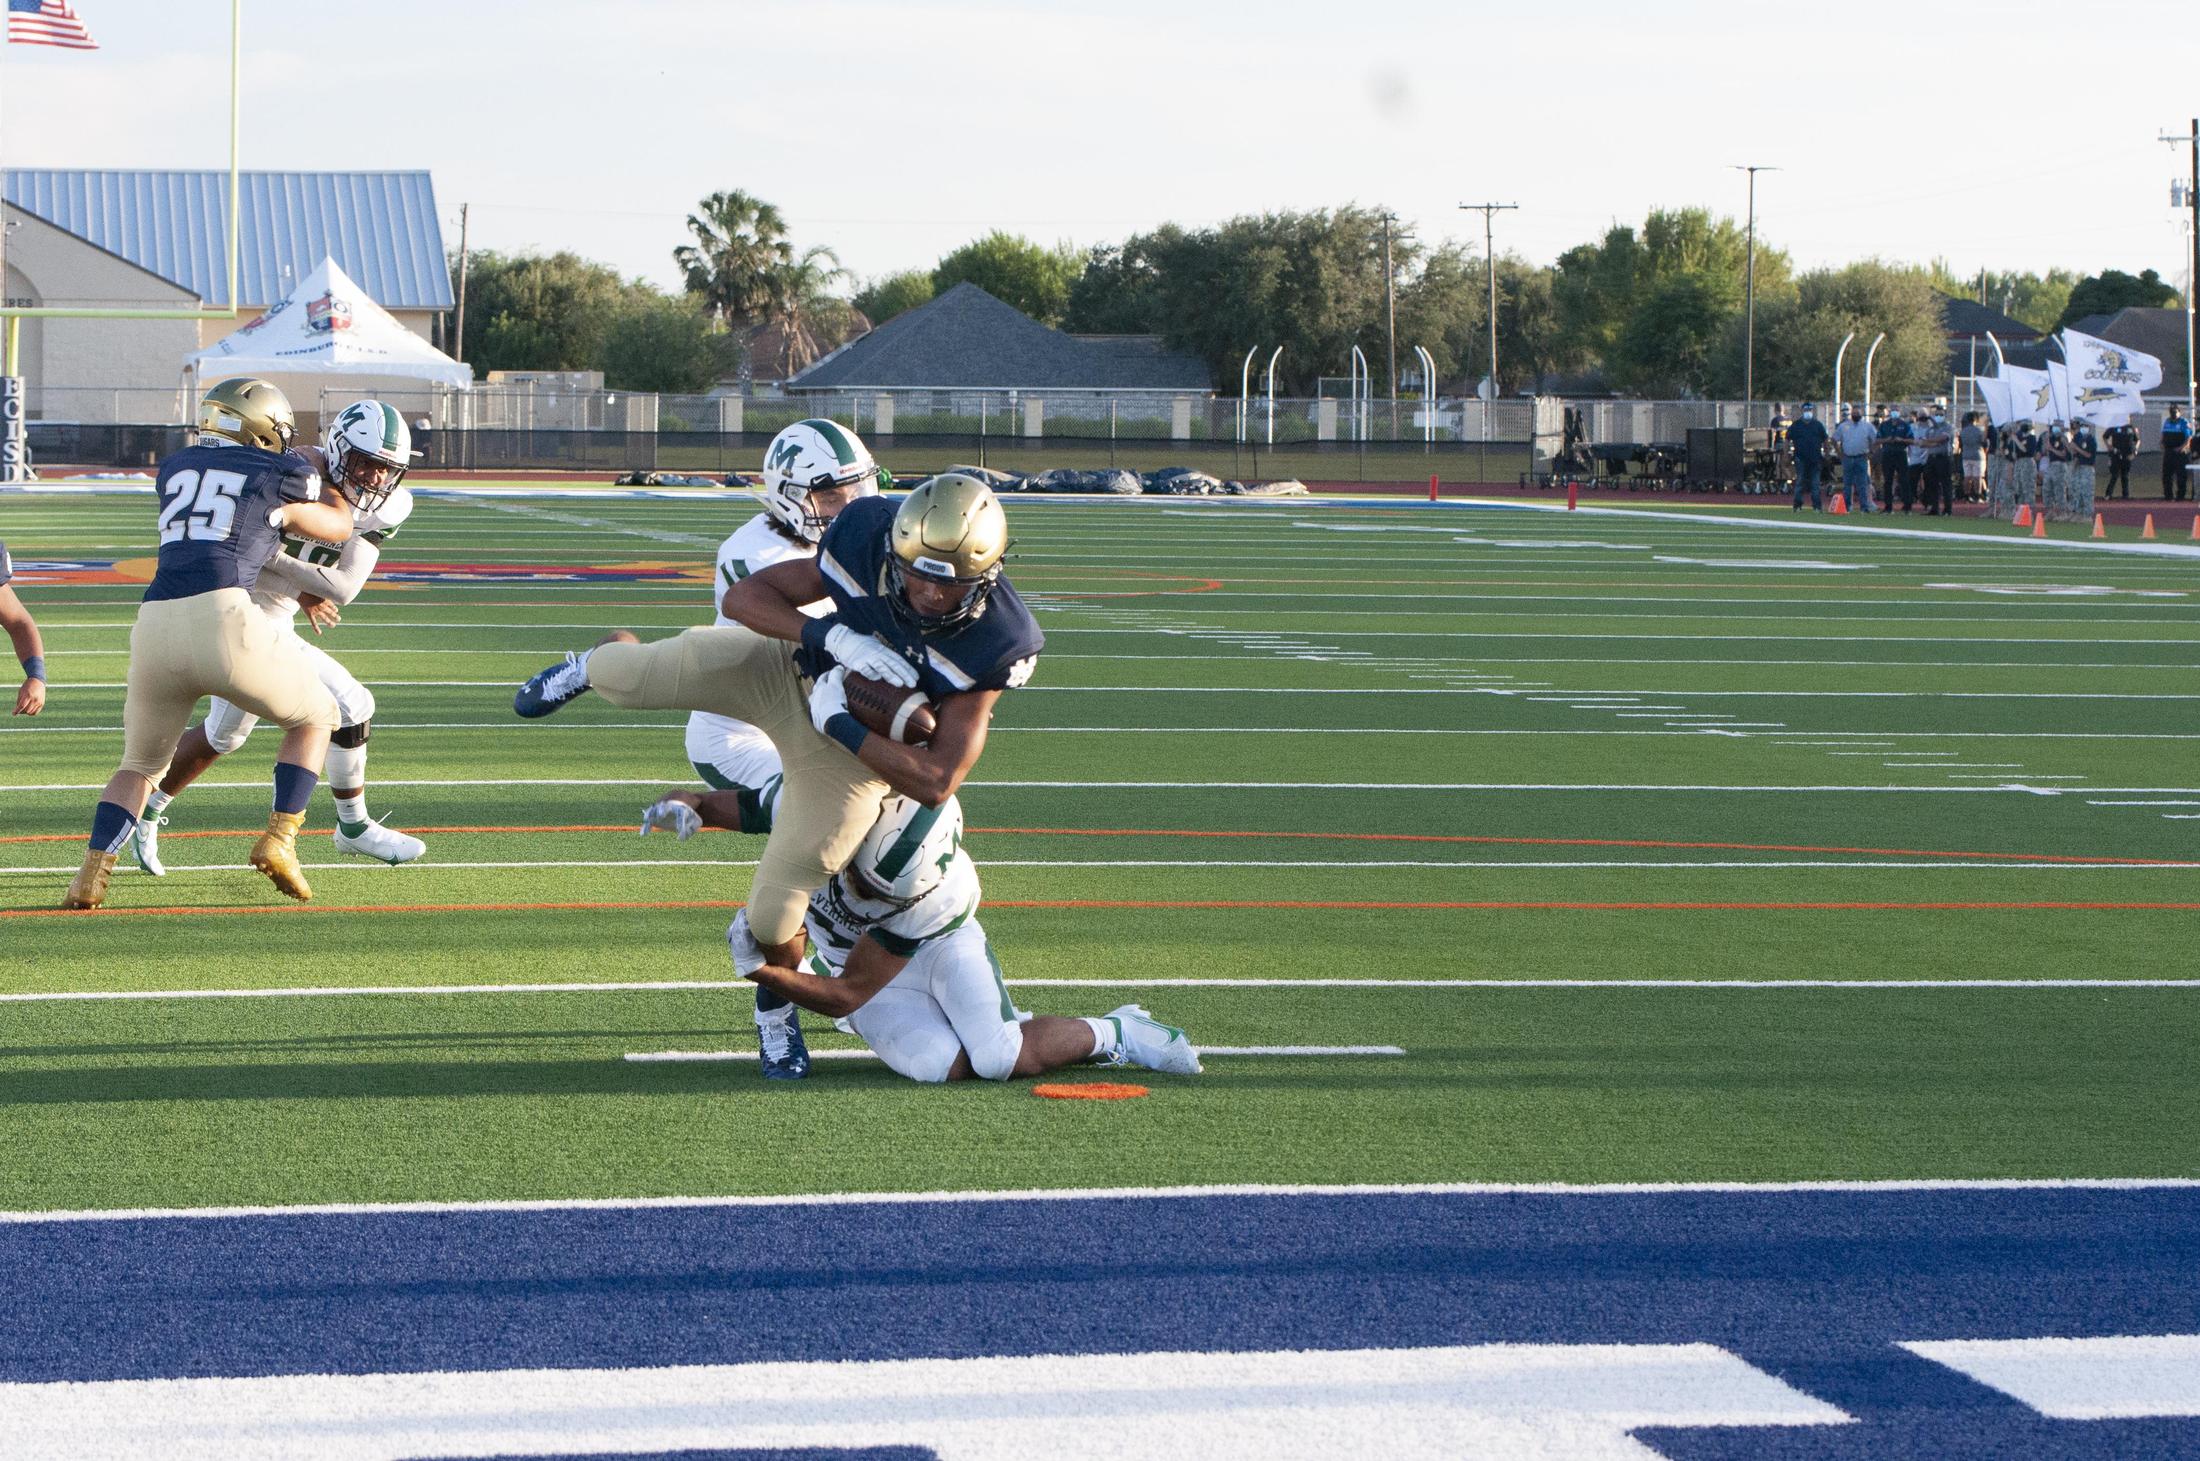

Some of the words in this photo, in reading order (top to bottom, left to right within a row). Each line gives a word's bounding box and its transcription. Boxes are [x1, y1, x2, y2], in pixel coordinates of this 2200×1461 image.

[275, 340, 341, 356] EDINBUR
[340, 403, 365, 432] M
[767, 438, 804, 479] M
[158, 468, 248, 547] 25
[923, 560, 946, 574] PROUD
